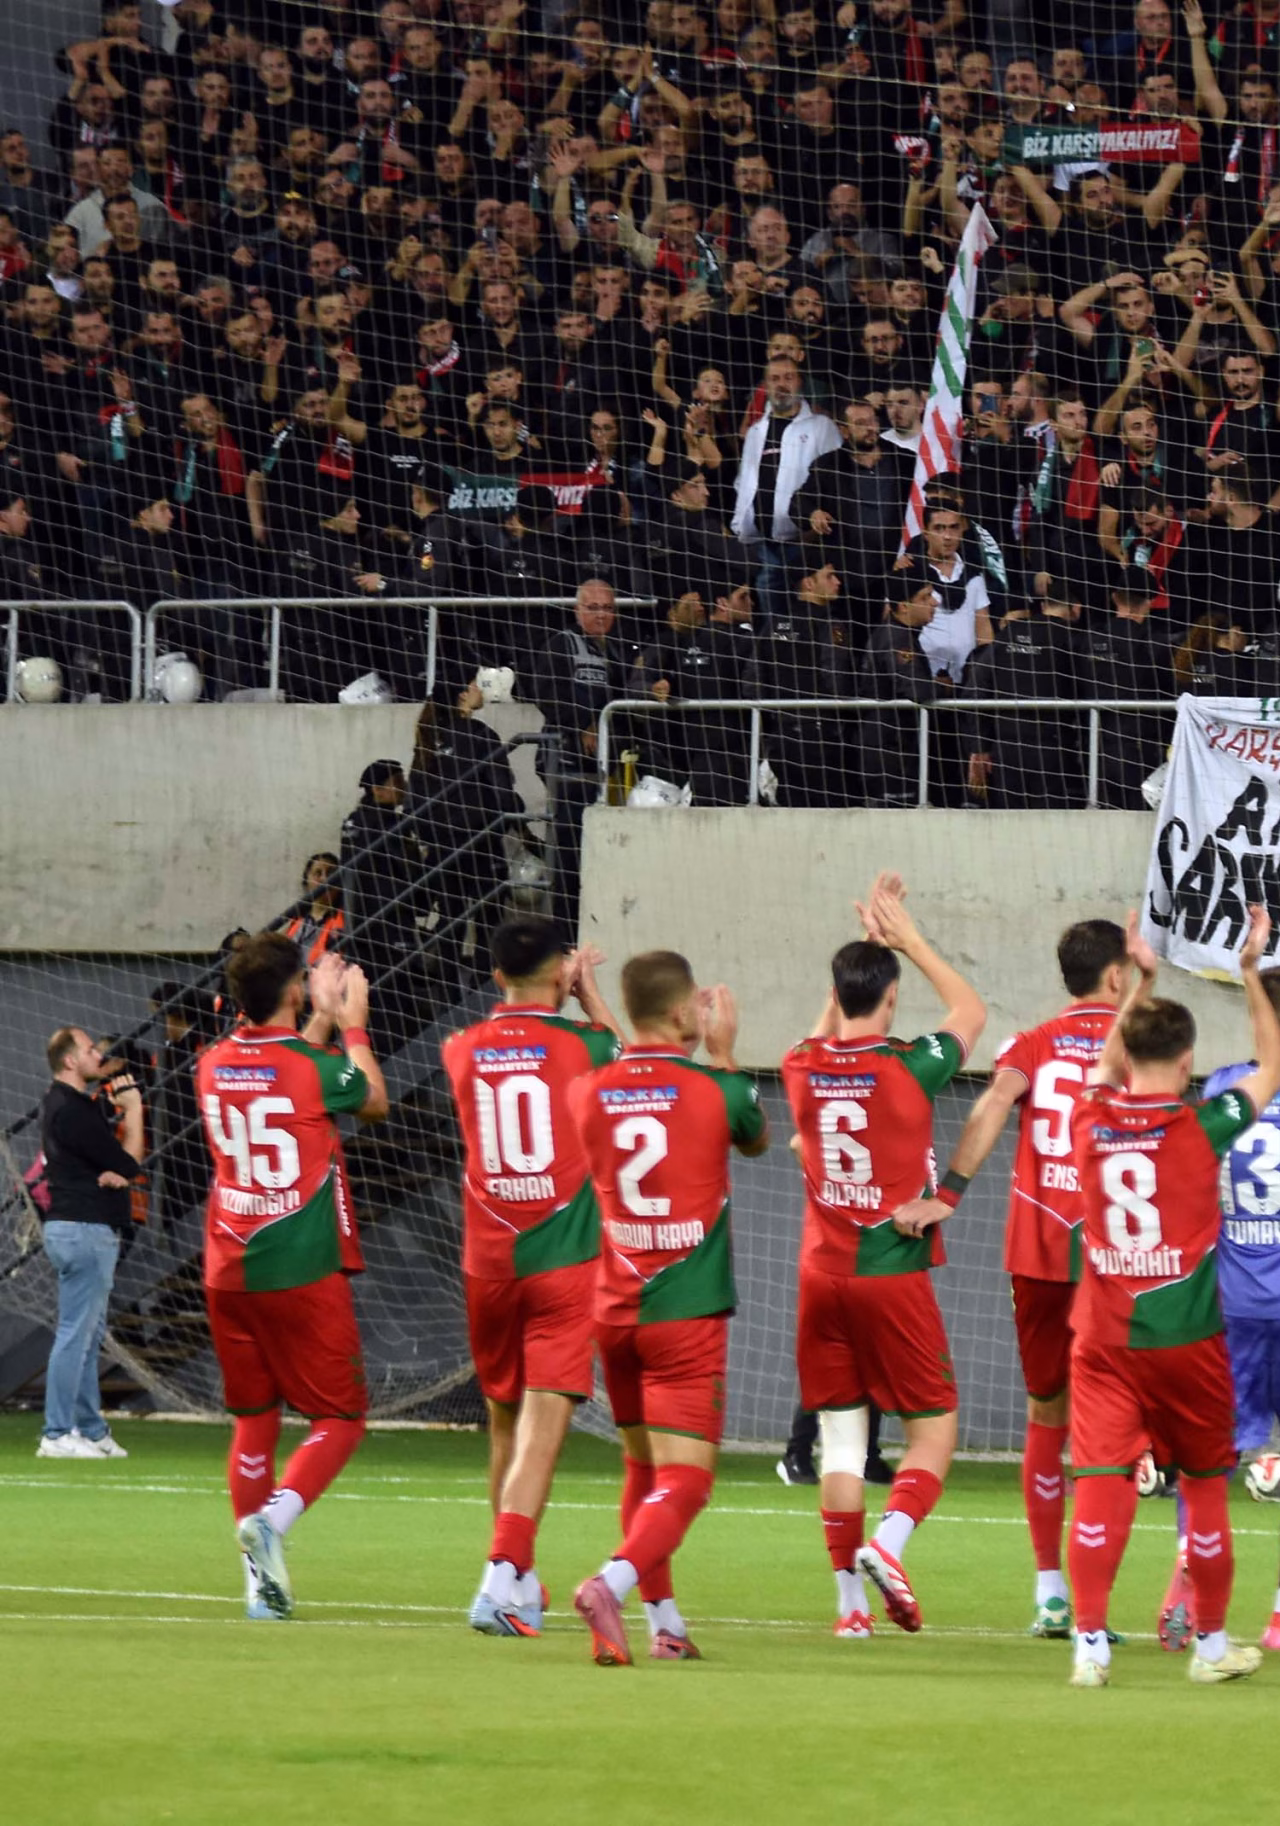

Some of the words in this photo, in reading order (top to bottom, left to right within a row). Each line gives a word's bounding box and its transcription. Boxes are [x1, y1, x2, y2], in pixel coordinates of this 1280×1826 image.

[1023, 132, 1049, 158] BİZ
[473, 1047, 547, 1062] TOLKAR
[1054, 1036, 1106, 1050] TOLKA
[214, 1067, 278, 1082] TOLKAR
[809, 1073, 876, 1088] TOLKAR
[601, 1087, 679, 1102] TOLKAR
[474, 1075, 555, 1174] 10
[205, 1094, 301, 1189] 45
[820, 1100, 874, 1185] 6
[614, 1116, 671, 1216] 2
[1042, 1162, 1082, 1192] ENS
[822, 1180, 882, 1210] ALPAY
[1103, 1151, 1162, 1252] 8
